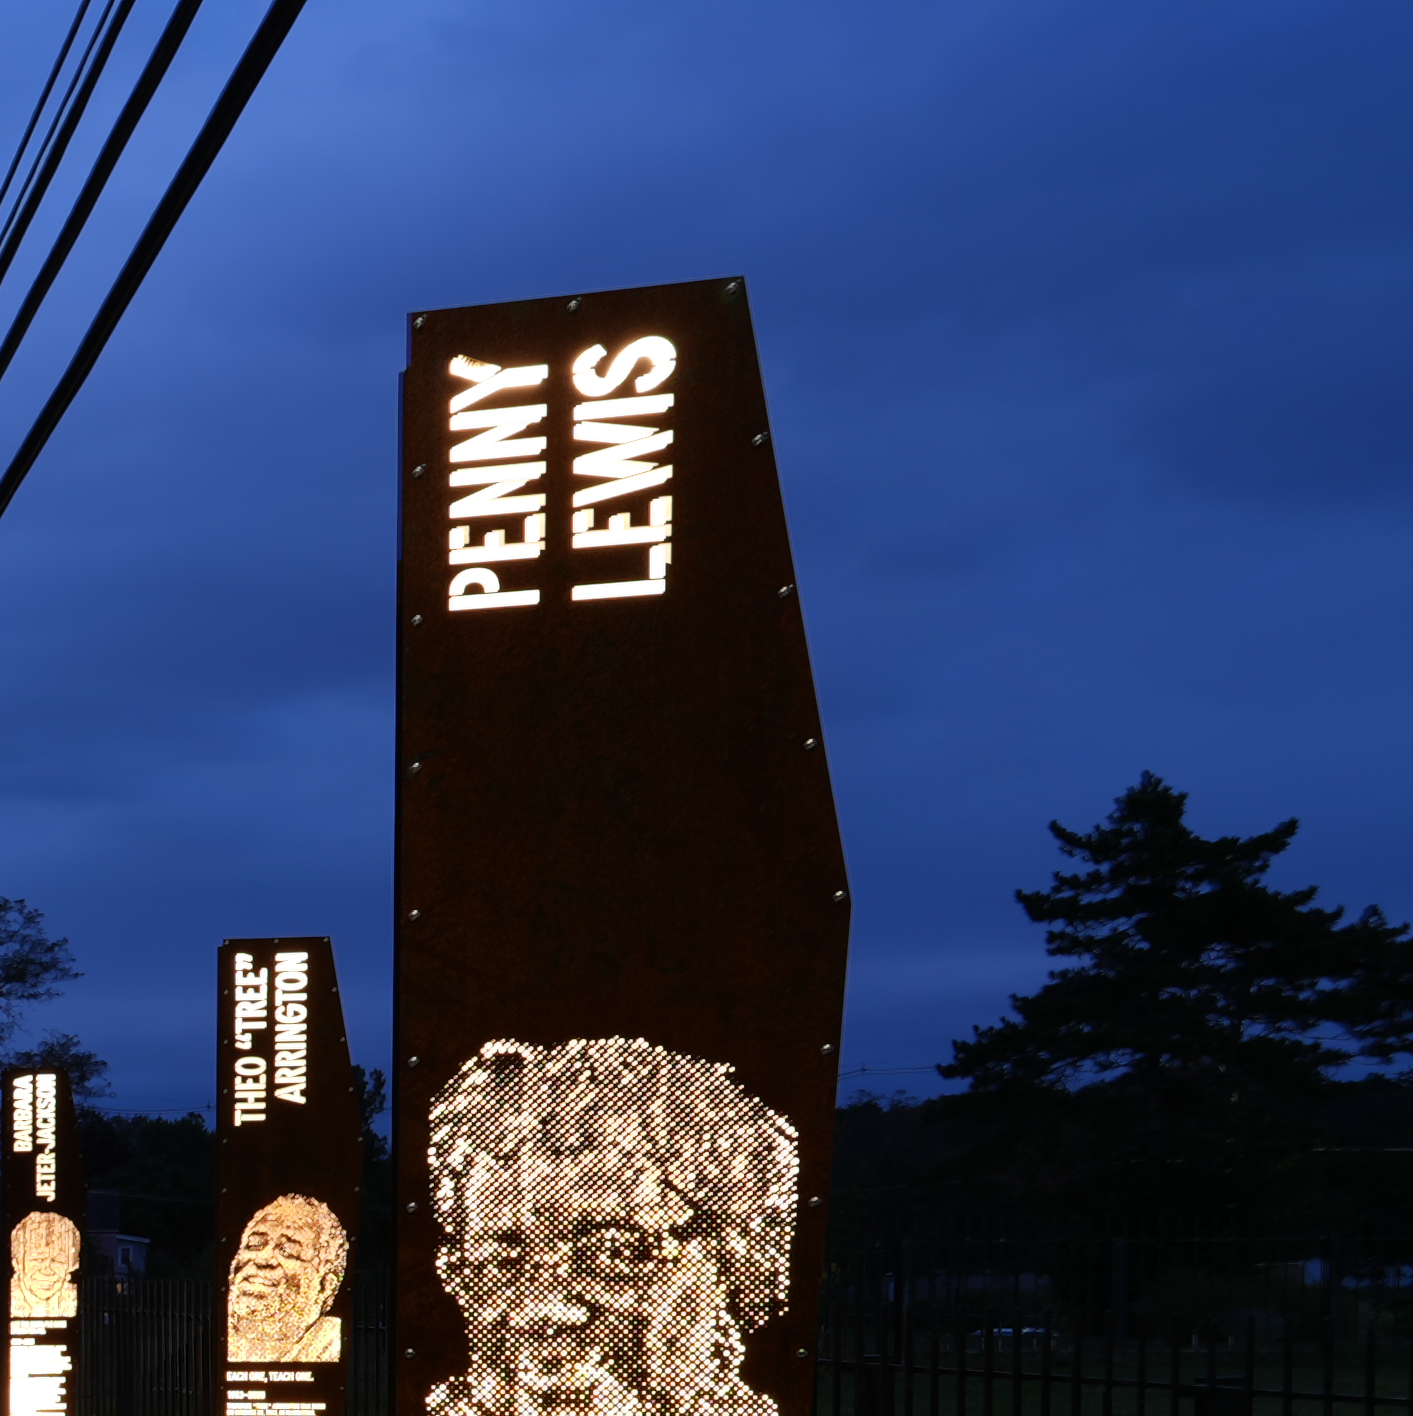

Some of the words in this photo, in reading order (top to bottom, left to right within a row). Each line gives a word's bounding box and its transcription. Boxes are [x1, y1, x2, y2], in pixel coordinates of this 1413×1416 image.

[449, 355, 548, 611] PENNY
[572, 335, 677, 600] LEWIS
[235, 953, 268, 1050] “TREE”
[275, 952, 308, 1104] ARRINGTON
[13, 1075, 33, 1152] BARBARA
[36, 1074, 56, 1201] JETER-JACKSON
[235, 1057, 266, 1126] THEO
